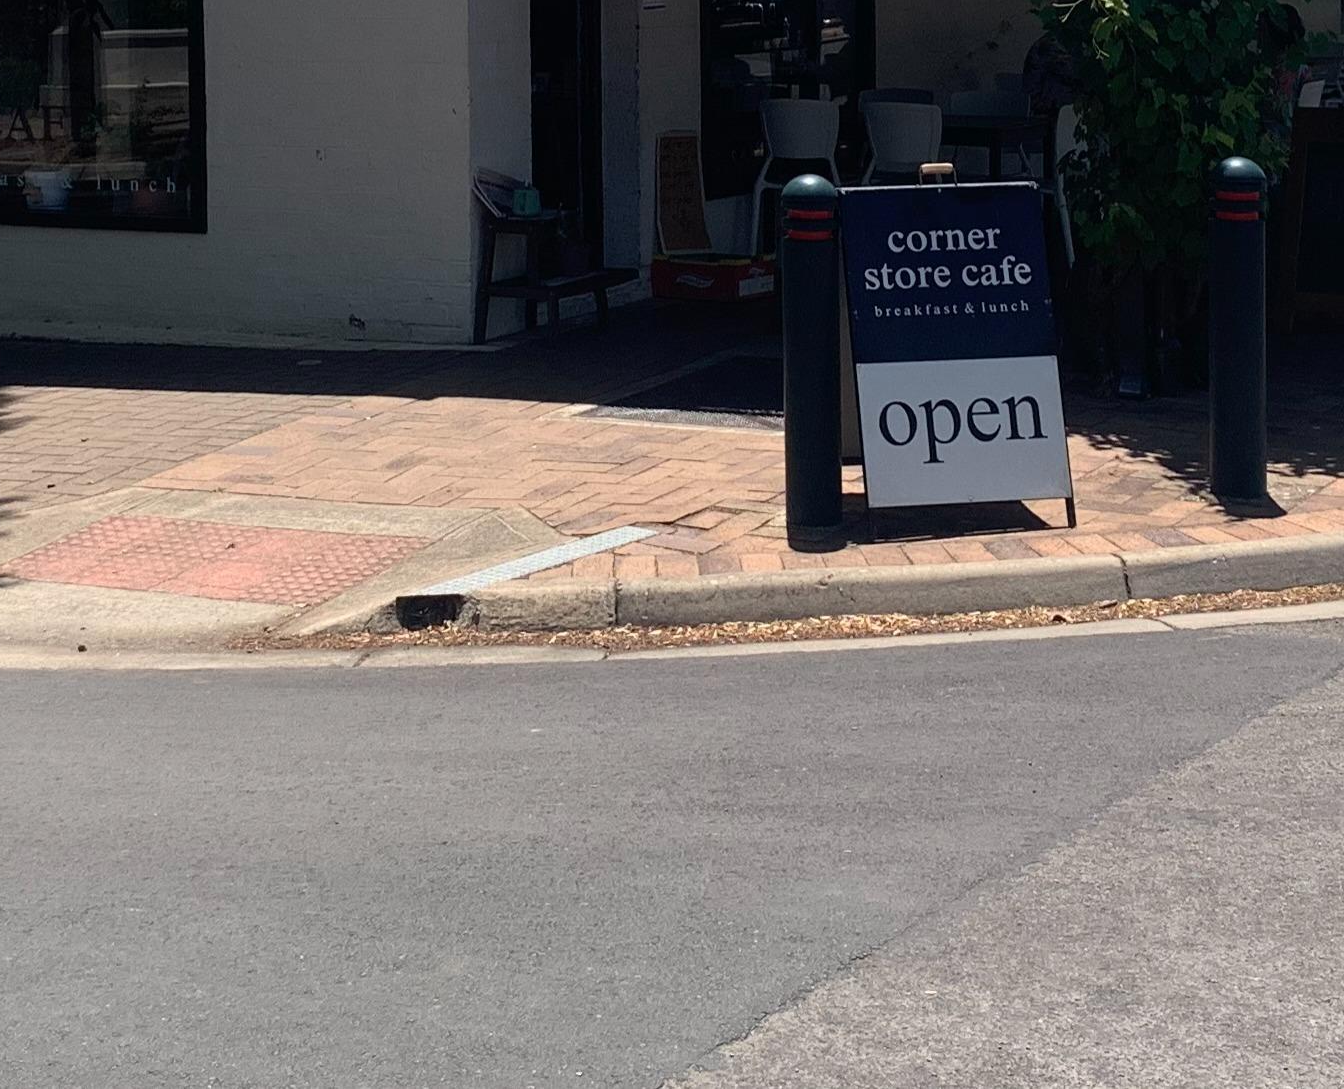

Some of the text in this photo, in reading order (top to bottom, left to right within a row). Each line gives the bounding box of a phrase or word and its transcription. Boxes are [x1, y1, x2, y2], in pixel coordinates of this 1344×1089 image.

[95, 174, 175, 194] lunch
[887, 227, 1000, 254] corner
[864, 255, 1033, 291] store cafe
[874, 299, 1030, 317] breakfast & lunch
[878, 395, 1048, 464] open
